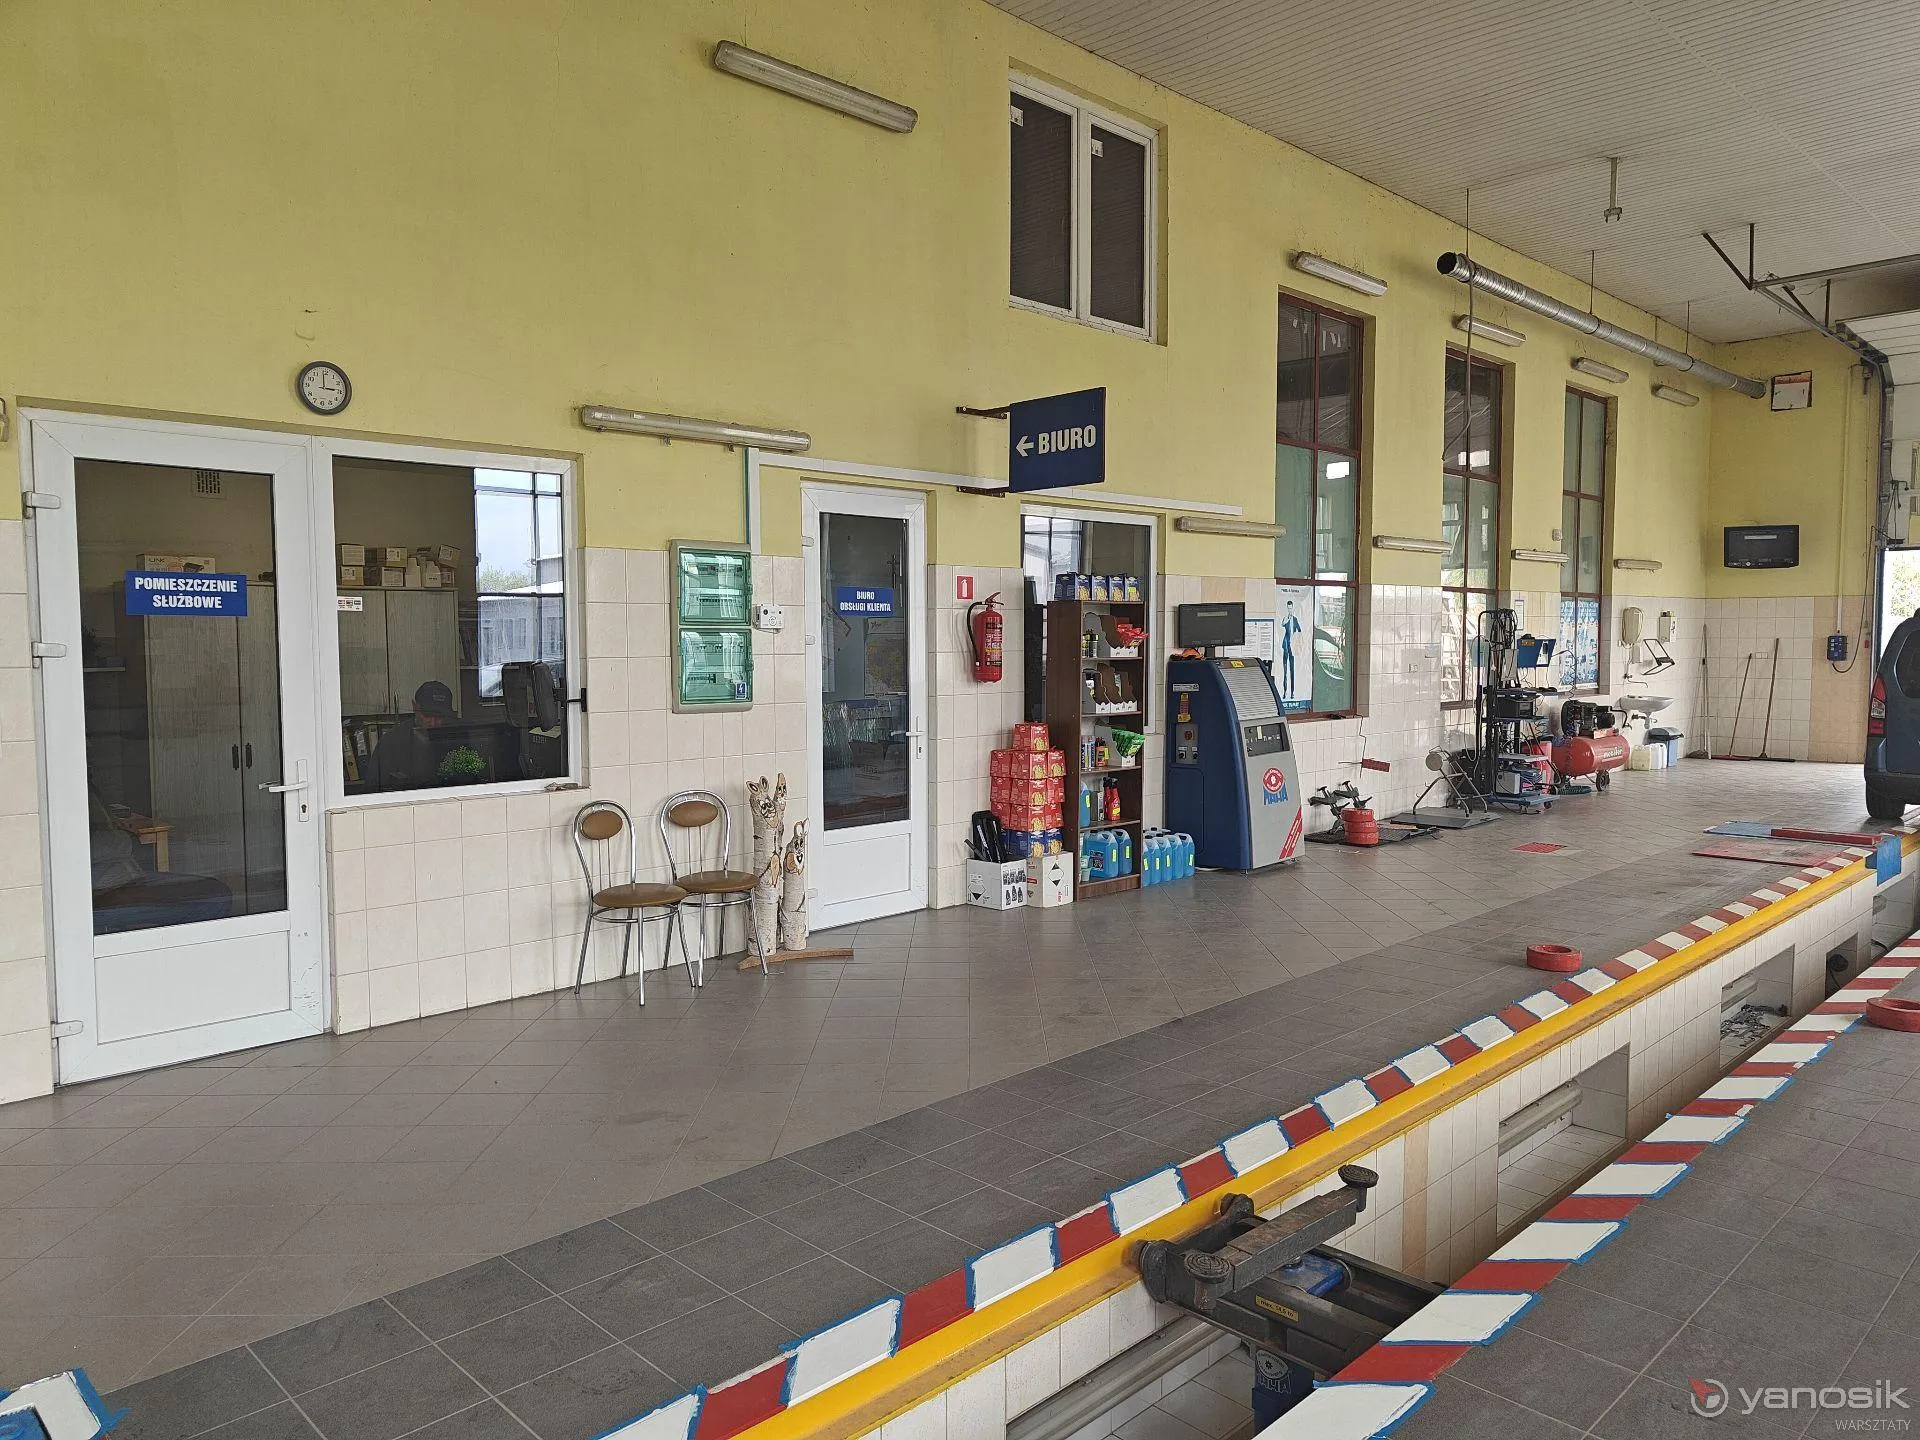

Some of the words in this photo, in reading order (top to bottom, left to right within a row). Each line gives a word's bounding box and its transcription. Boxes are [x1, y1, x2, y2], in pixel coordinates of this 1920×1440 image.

[1038, 424, 1096, 455] BIURO
[134, 576, 238, 593] POMIESZCZENIE
[152, 593, 223, 609] SŁUŻBOWE
[856, 590, 875, 600] BIURO
[840, 601, 866, 611] OBSŁUGI
[866, 602, 891, 612] KLIENTA
